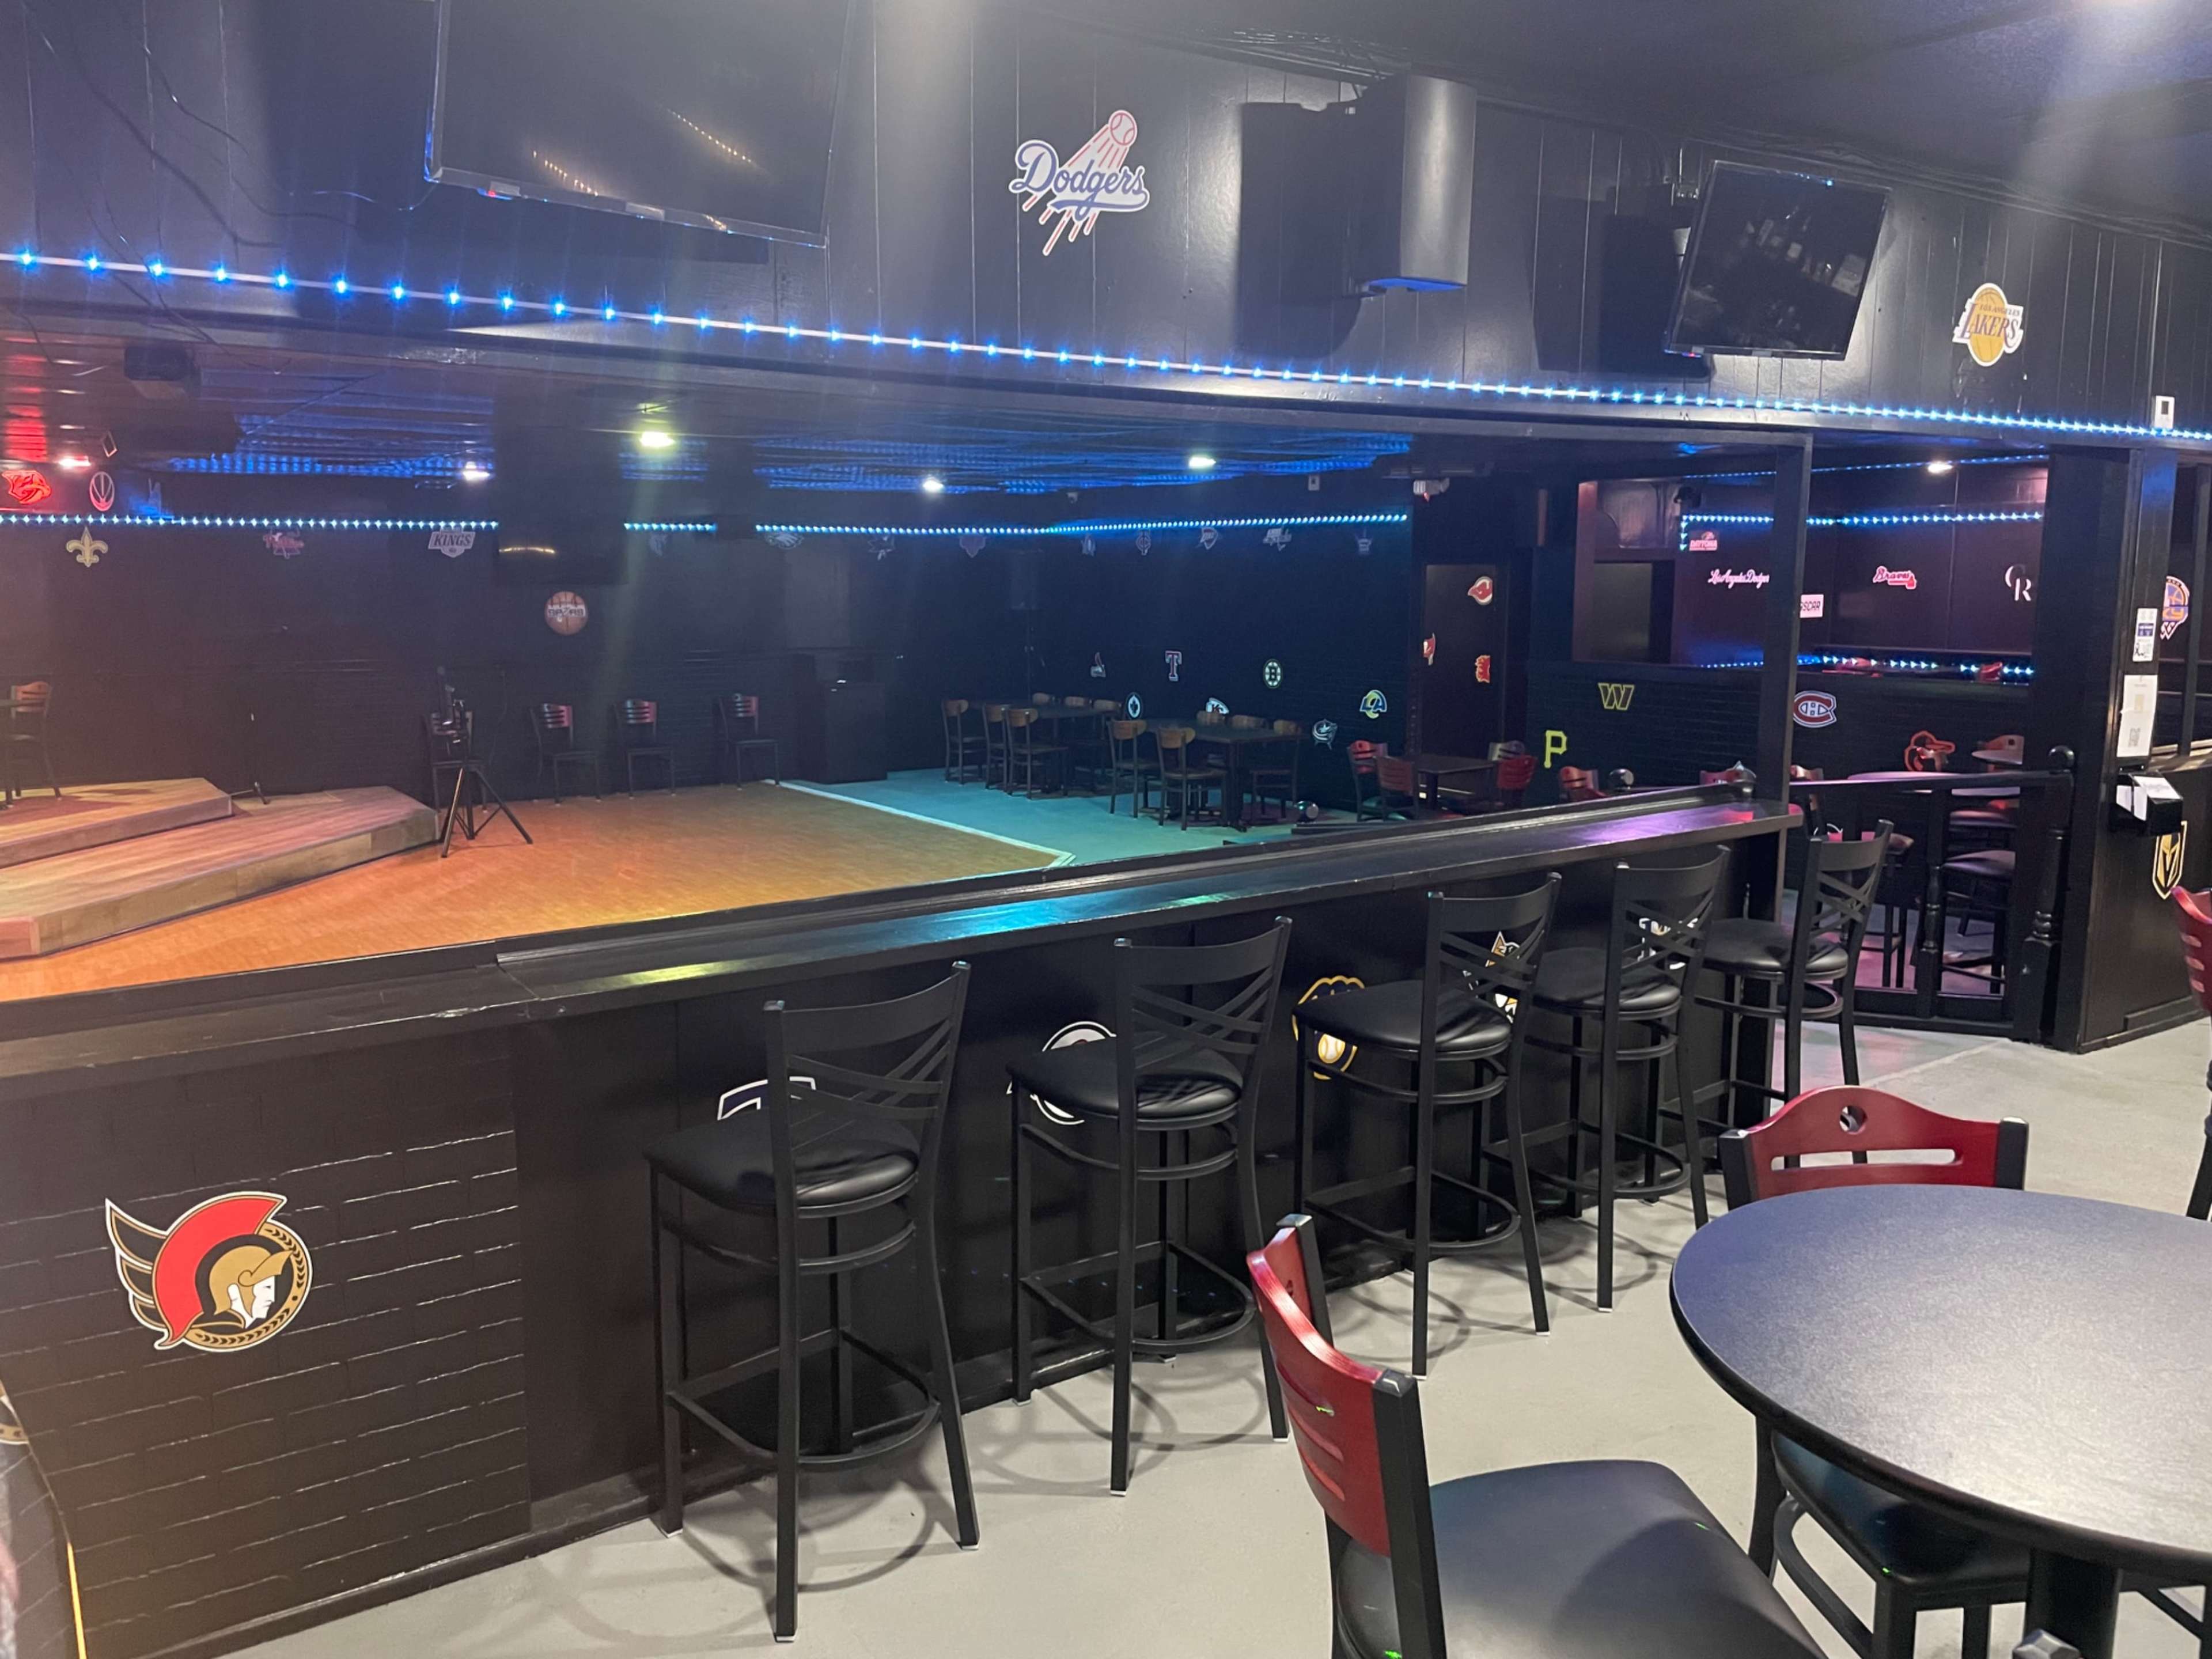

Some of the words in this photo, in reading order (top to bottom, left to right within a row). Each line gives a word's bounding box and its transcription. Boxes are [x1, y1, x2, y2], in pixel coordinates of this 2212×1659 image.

[1010, 142, 1147, 222] Dodgers
[1957, 303, 2018, 348] LAKERS
[433, 533, 471, 547] KINGS
[1165, 650, 1181, 681] T
[1597, 682, 1635, 711] W
[1544, 730, 1567, 768] P
